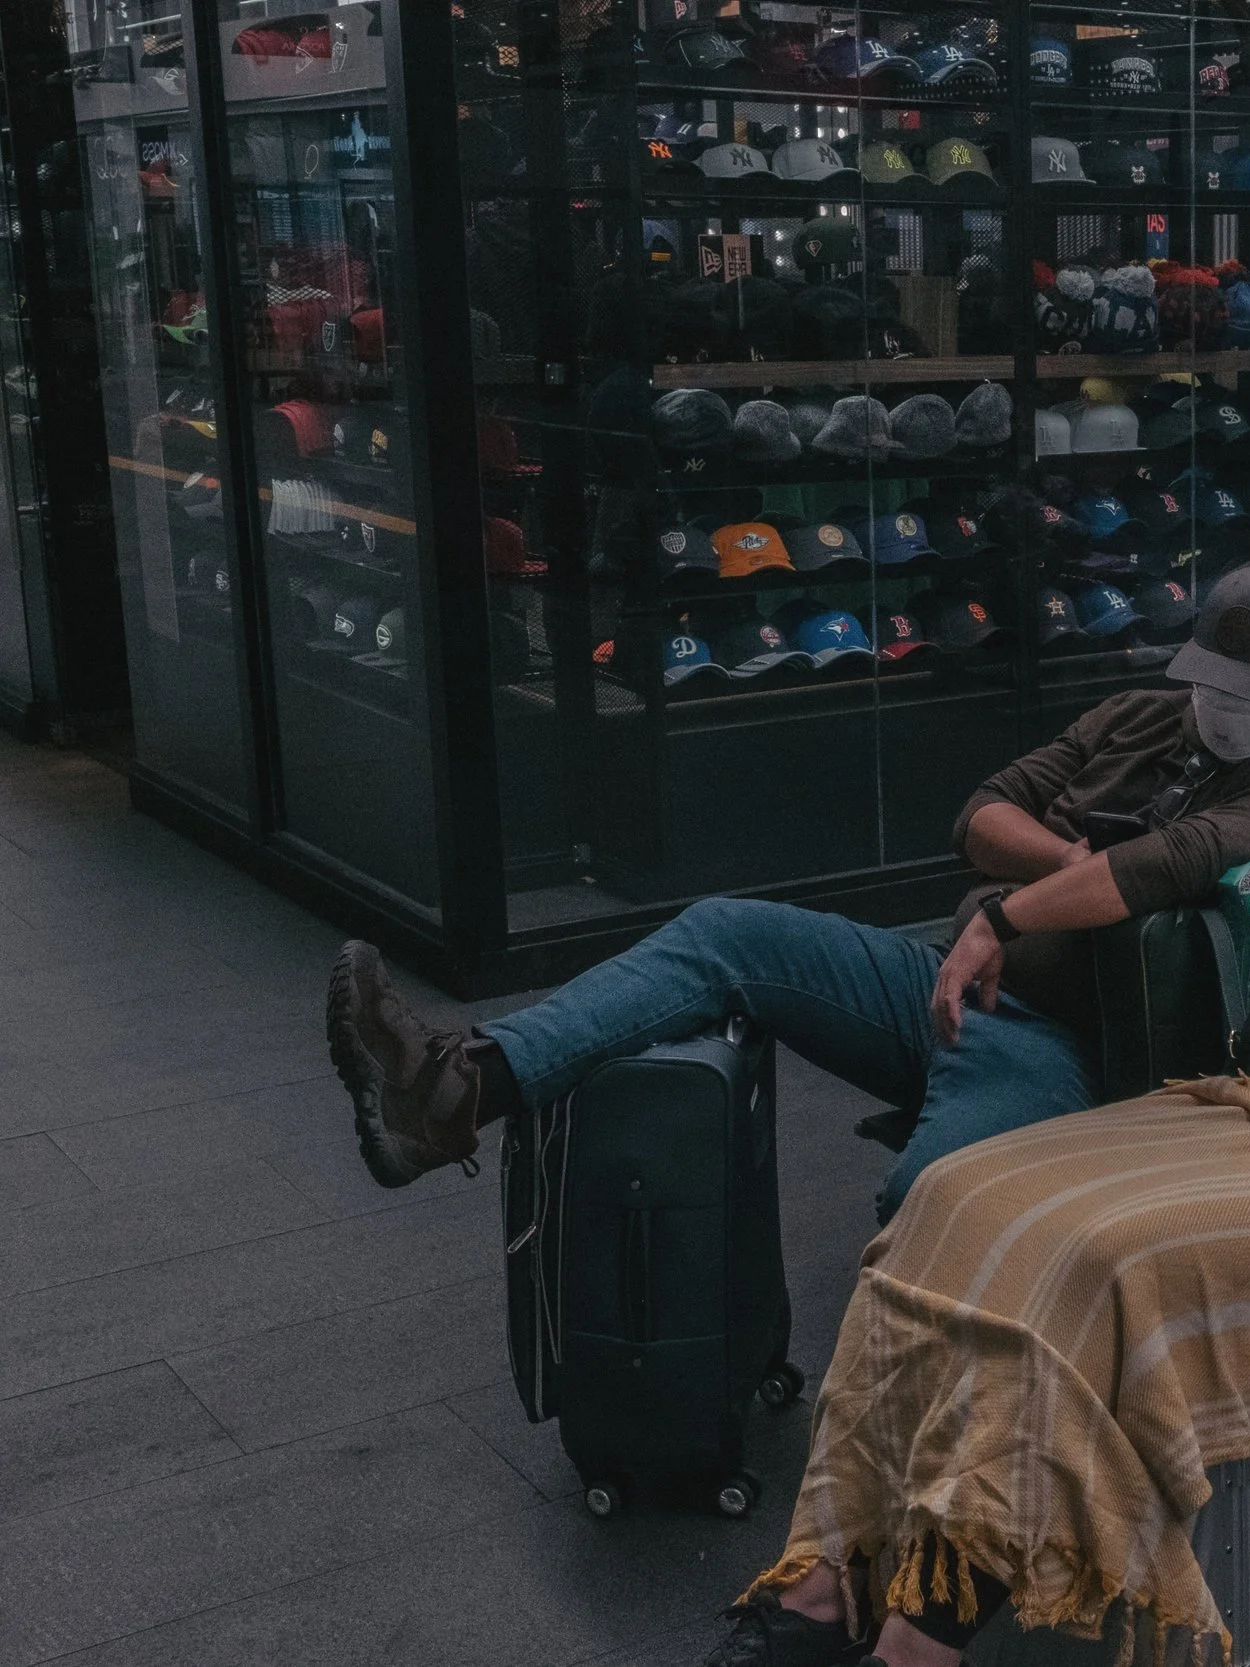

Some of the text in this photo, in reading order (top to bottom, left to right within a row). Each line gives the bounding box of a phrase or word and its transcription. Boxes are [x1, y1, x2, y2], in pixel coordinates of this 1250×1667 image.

[865, 40, 889, 58] LA
[941, 44, 965, 61] LA
[647, 139, 673, 159] NY
[729, 148, 753, 168] NY
[816, 145, 839, 166] NY
[884, 149, 905, 169] NY
[951, 144, 972, 165] NY
[1048, 149, 1067, 173] NY
[728, 246, 746, 261] NEW
[1215, 490, 1236, 508] LA
[1103, 591, 1126, 609] LA
[890, 615, 913, 637] B
[672, 636, 697, 658] D
